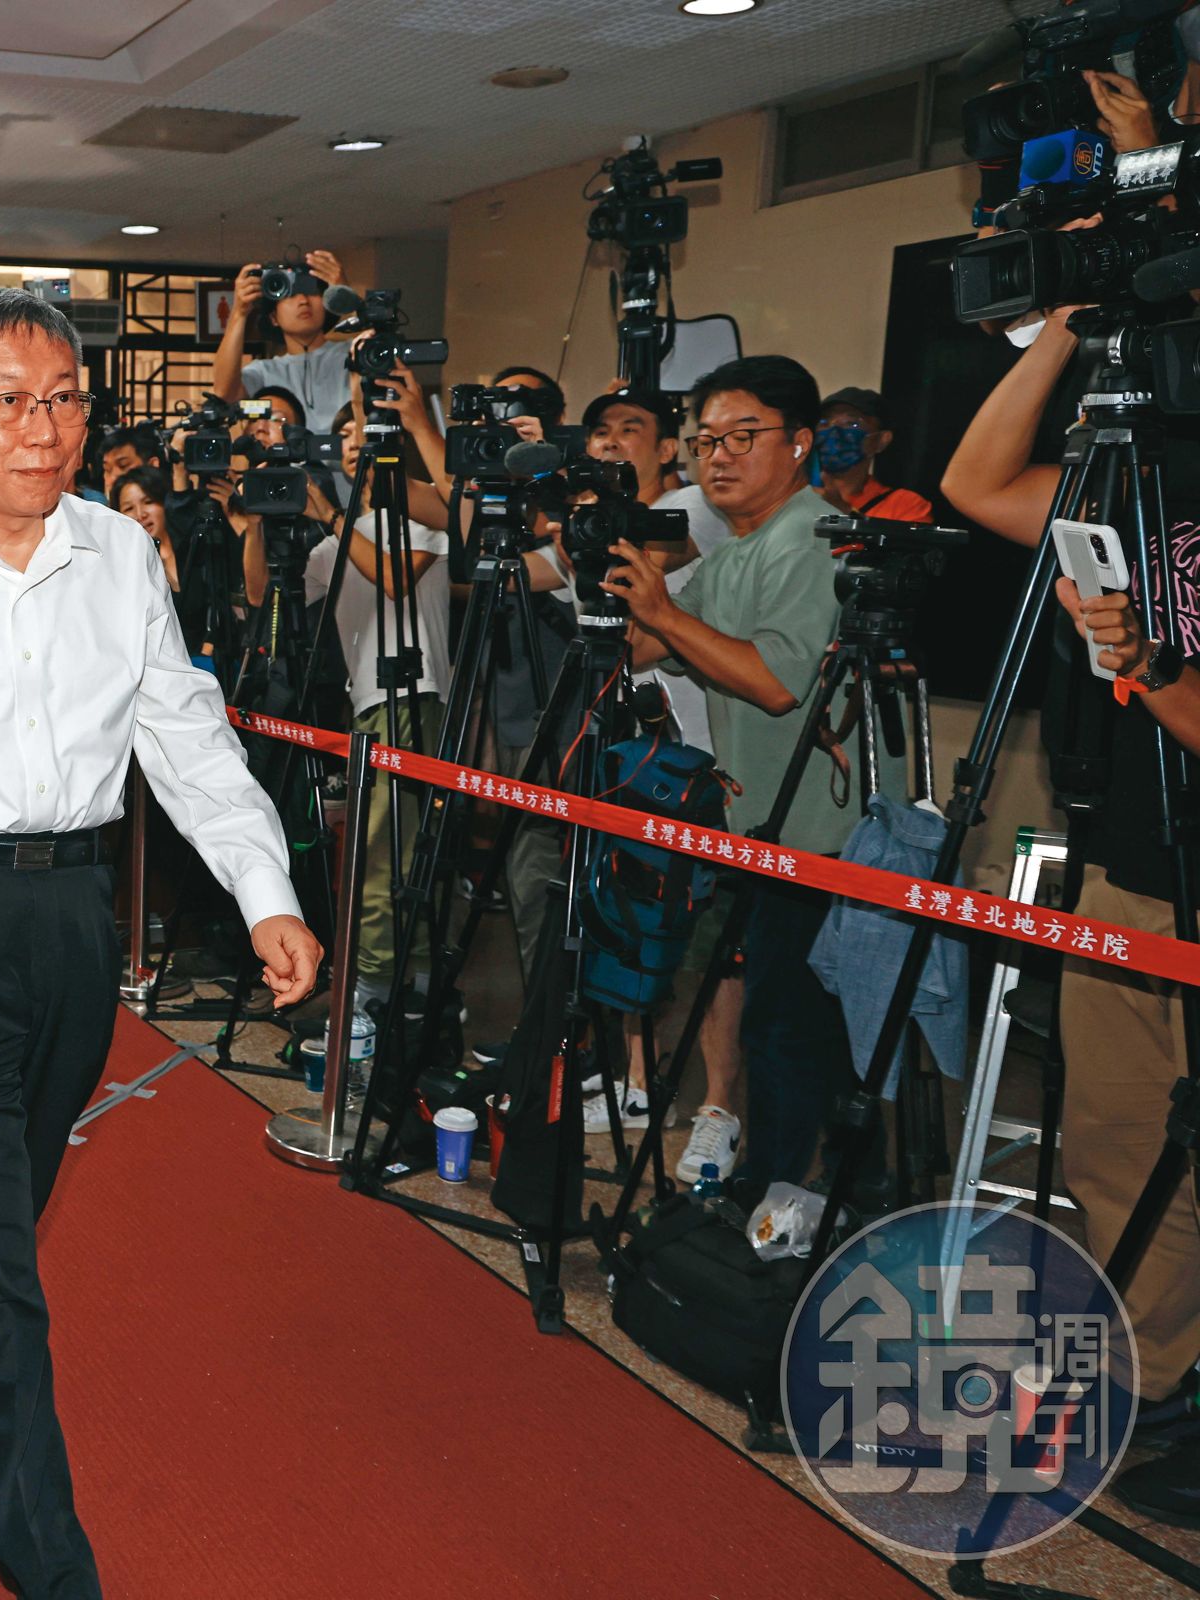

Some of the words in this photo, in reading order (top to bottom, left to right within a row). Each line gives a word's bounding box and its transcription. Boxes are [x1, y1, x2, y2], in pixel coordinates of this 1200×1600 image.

[456, 770, 569, 817] 臺灣臺北地方法院
[642, 818, 797, 878] 臺灣臺北地方法院
[905, 883, 1130, 961] 臺灣臺北地方法院
